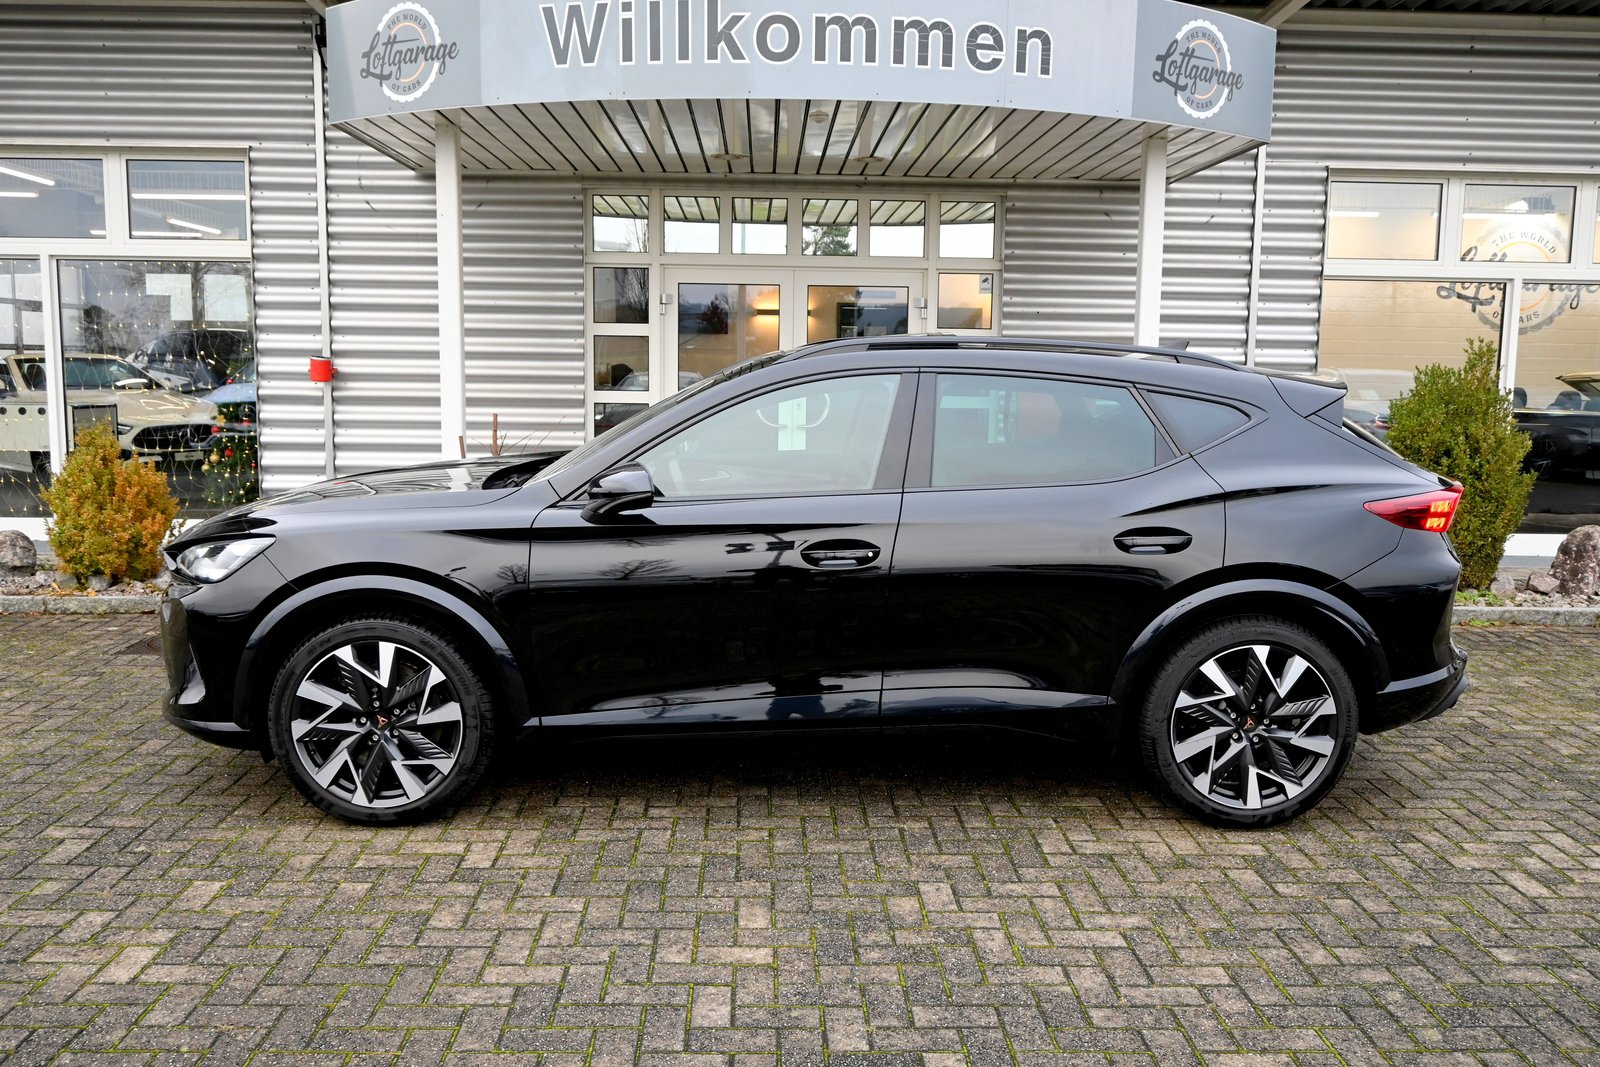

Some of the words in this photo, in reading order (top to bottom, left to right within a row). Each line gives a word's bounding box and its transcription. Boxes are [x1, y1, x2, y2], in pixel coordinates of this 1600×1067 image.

[387, 16, 400, 30] THE
[403, 13, 427, 30] WORLD
[539, 0, 1053, 78] Willkommen
[1186, 32, 1199, 42] THE
[1201, 31, 1222, 54] WORLD
[360, 31, 460, 87] Loftgarage
[1152, 39, 1243, 101] Loftgarage
[391, 82, 401, 92] OF
[402, 79, 421, 93] CARS
[1186, 96, 1195, 106] OF
[1196, 99, 1213, 109] CARS
[1492, 232, 1515, 247] THE
[1520, 231, 1556, 255] WORLD
